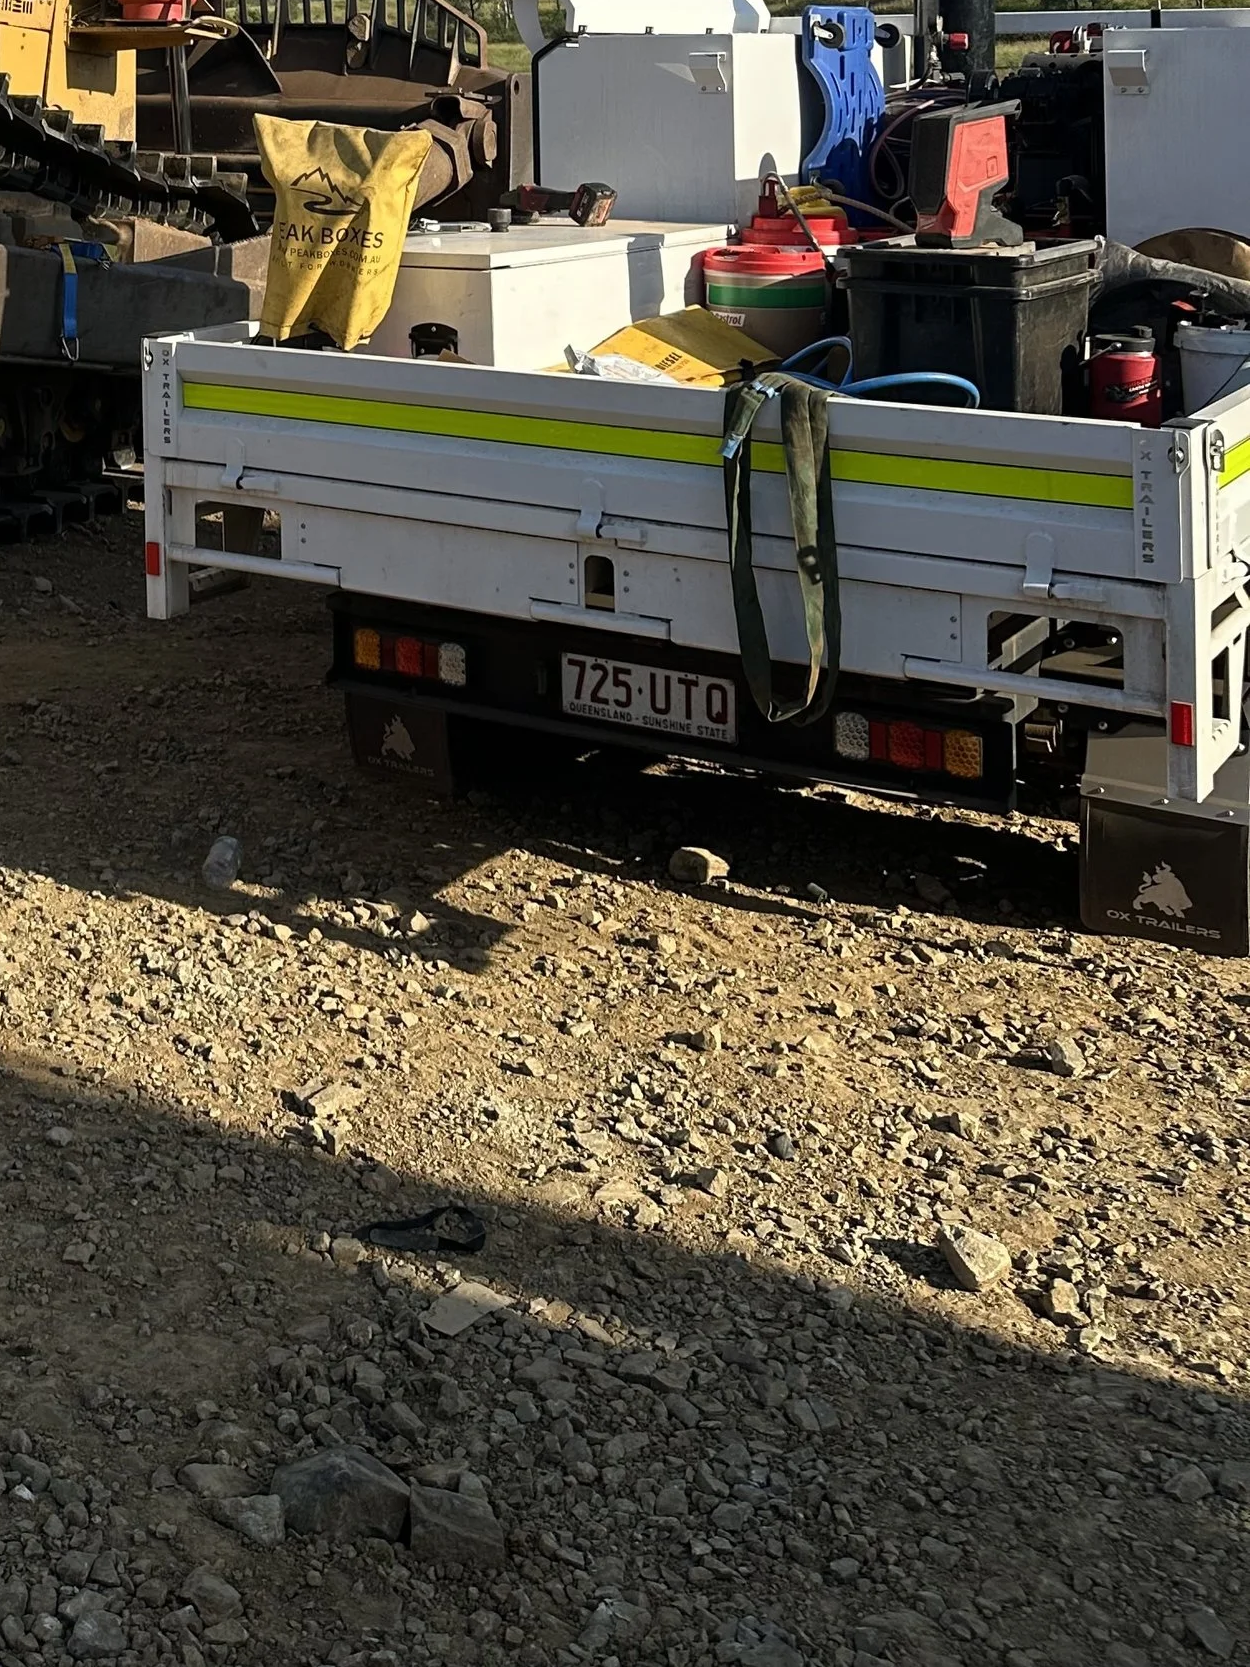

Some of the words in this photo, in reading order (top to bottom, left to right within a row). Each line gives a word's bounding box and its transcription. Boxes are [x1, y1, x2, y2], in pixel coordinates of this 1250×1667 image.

[279, 222, 315, 244] EAK
[321, 226, 384, 249] BOXES
[300, 261, 323, 271] FOR
[162, 349, 170, 366] OX
[162, 373, 171, 444] TRAILERS
[1138, 470, 1155, 564] TRAILERS
[569, 702, 632, 722] QUEENSLAND
[642, 716, 692, 734] SUNSHINE
[697, 725, 727, 740] STATE
[1106, 909, 1131, 921] OX
[1135, 915, 1221, 939] TRAILERS
